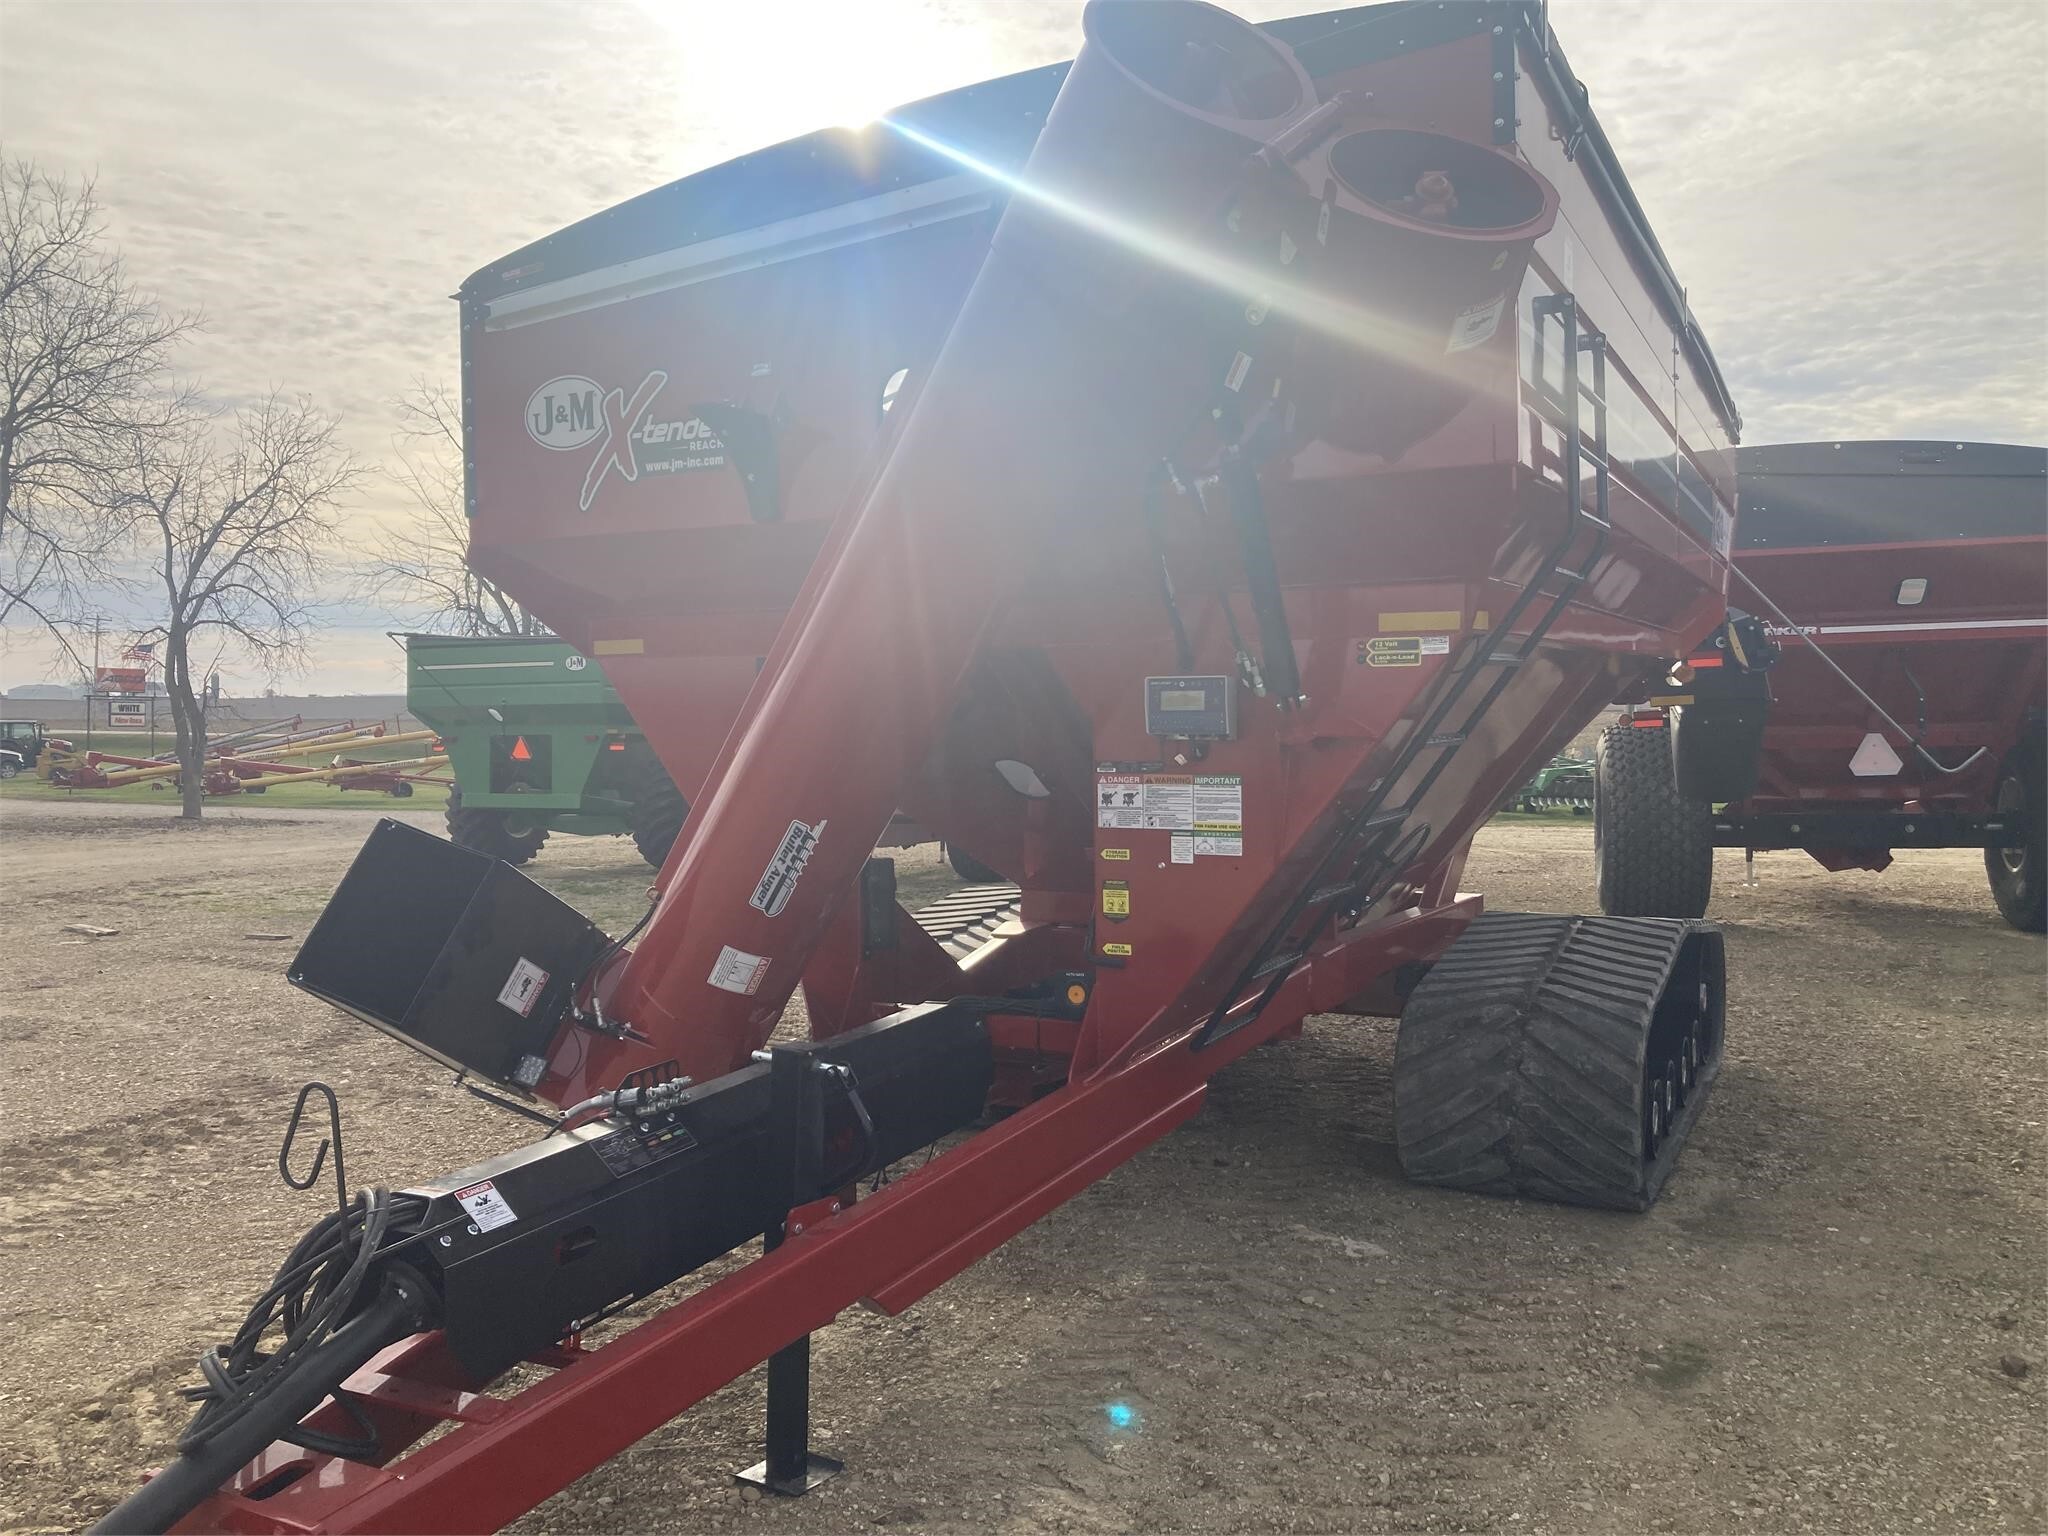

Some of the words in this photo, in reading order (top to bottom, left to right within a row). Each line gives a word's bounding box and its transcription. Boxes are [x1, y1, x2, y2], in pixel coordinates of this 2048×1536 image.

[532, 390, 596, 437] J&M
[580, 370, 717, 511] X-tende
[645, 456, 724, 472] www.jm-inc.com
[118, 704, 140, 712] WHITE
[1107, 776, 1140, 784] DANGER
[1153, 776, 1191, 784] WARNING
[1194, 776, 1241, 785] IMPORTANT
[777, 825, 804, 865] Bullet
[757, 865, 782, 905] Auger
